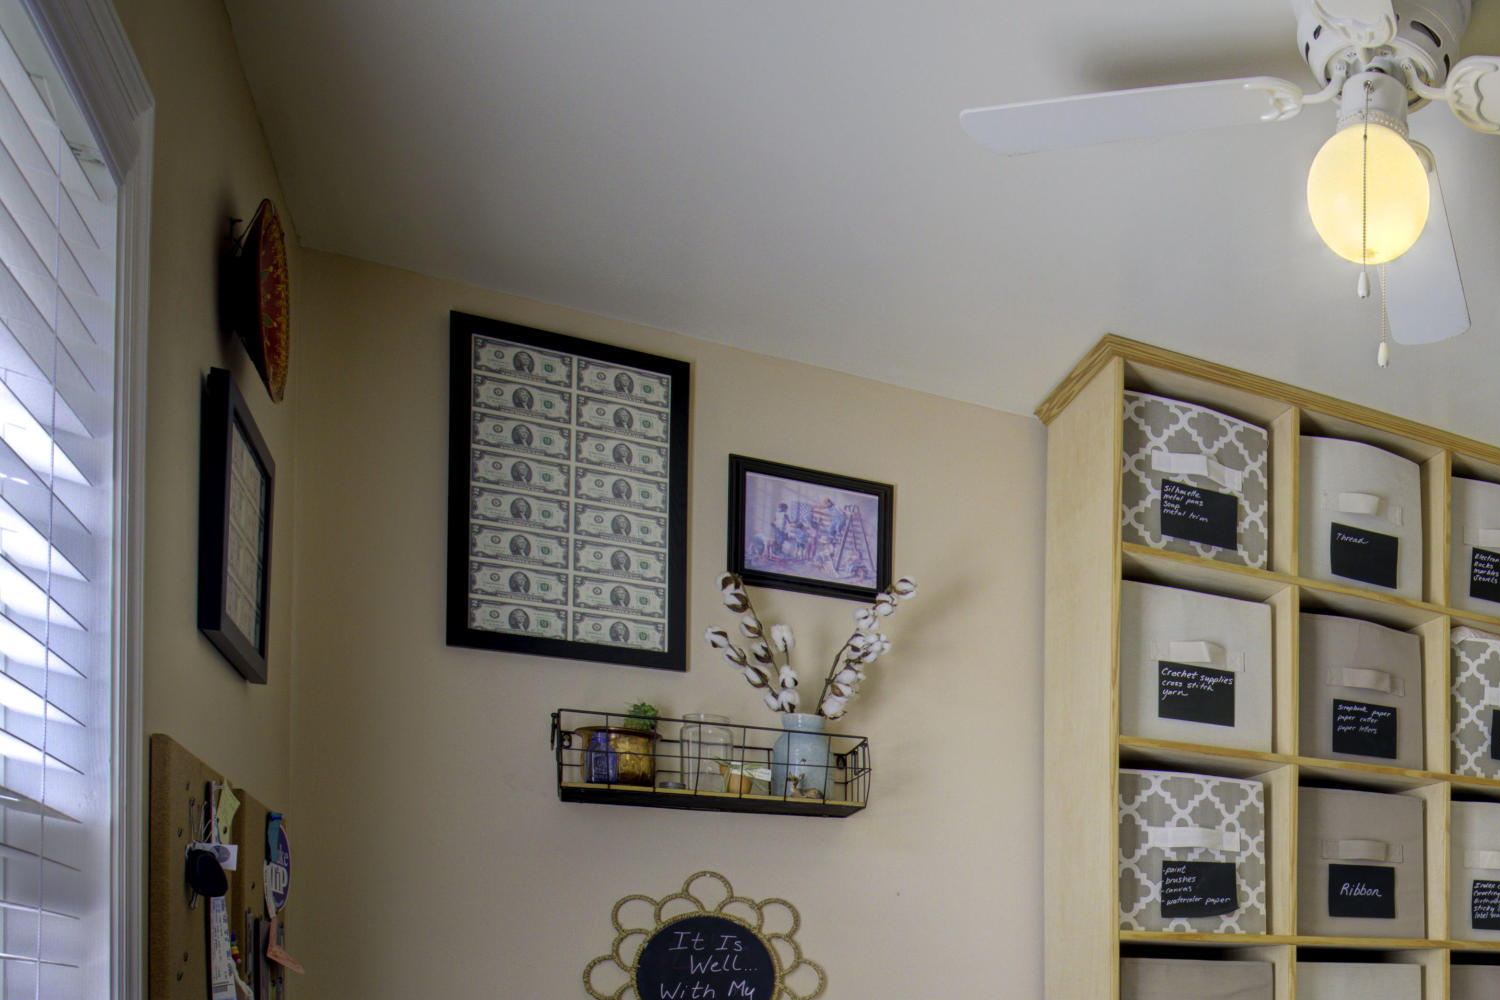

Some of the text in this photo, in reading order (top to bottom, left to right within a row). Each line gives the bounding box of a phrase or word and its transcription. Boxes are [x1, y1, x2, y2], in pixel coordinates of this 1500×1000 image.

[1161, 667, 1199, 680] Crochet
[1340, 882, 1383, 898] Ribbon
[668, 931, 743, 952] It Is
[660, 981, 716, 1000] With
